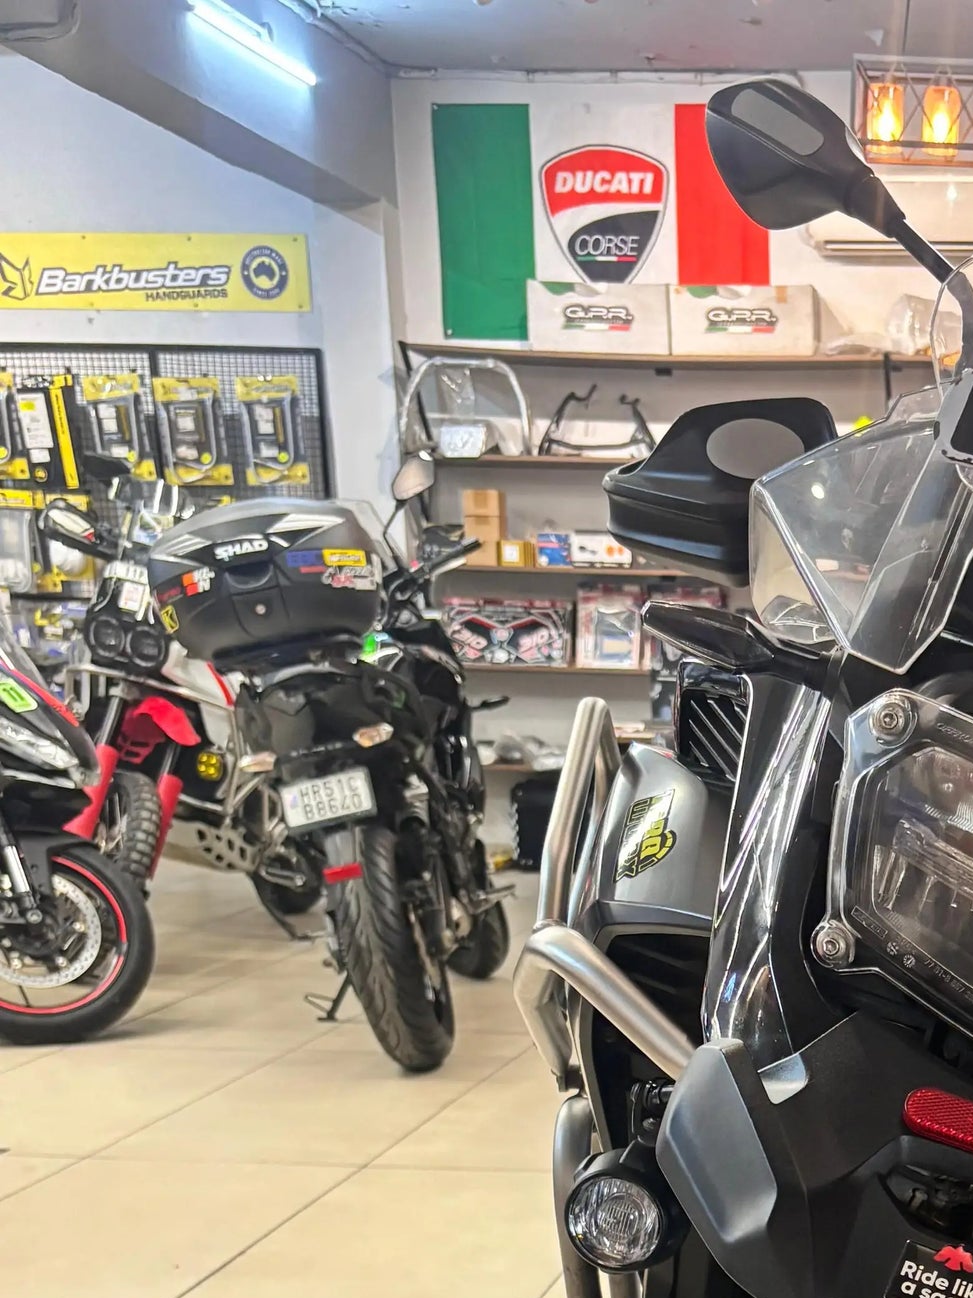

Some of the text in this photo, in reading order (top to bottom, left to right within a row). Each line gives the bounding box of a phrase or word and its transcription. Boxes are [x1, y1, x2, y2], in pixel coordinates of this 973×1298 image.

[555, 171, 654, 194] DUCATI
[575, 234, 639, 257] CORSE
[35, 262, 233, 296] Barkbusters
[214, 540, 268, 561] SHAD
[900, 1260, 949, 1291] Ride
[900, 1281, 917, 1296] a
